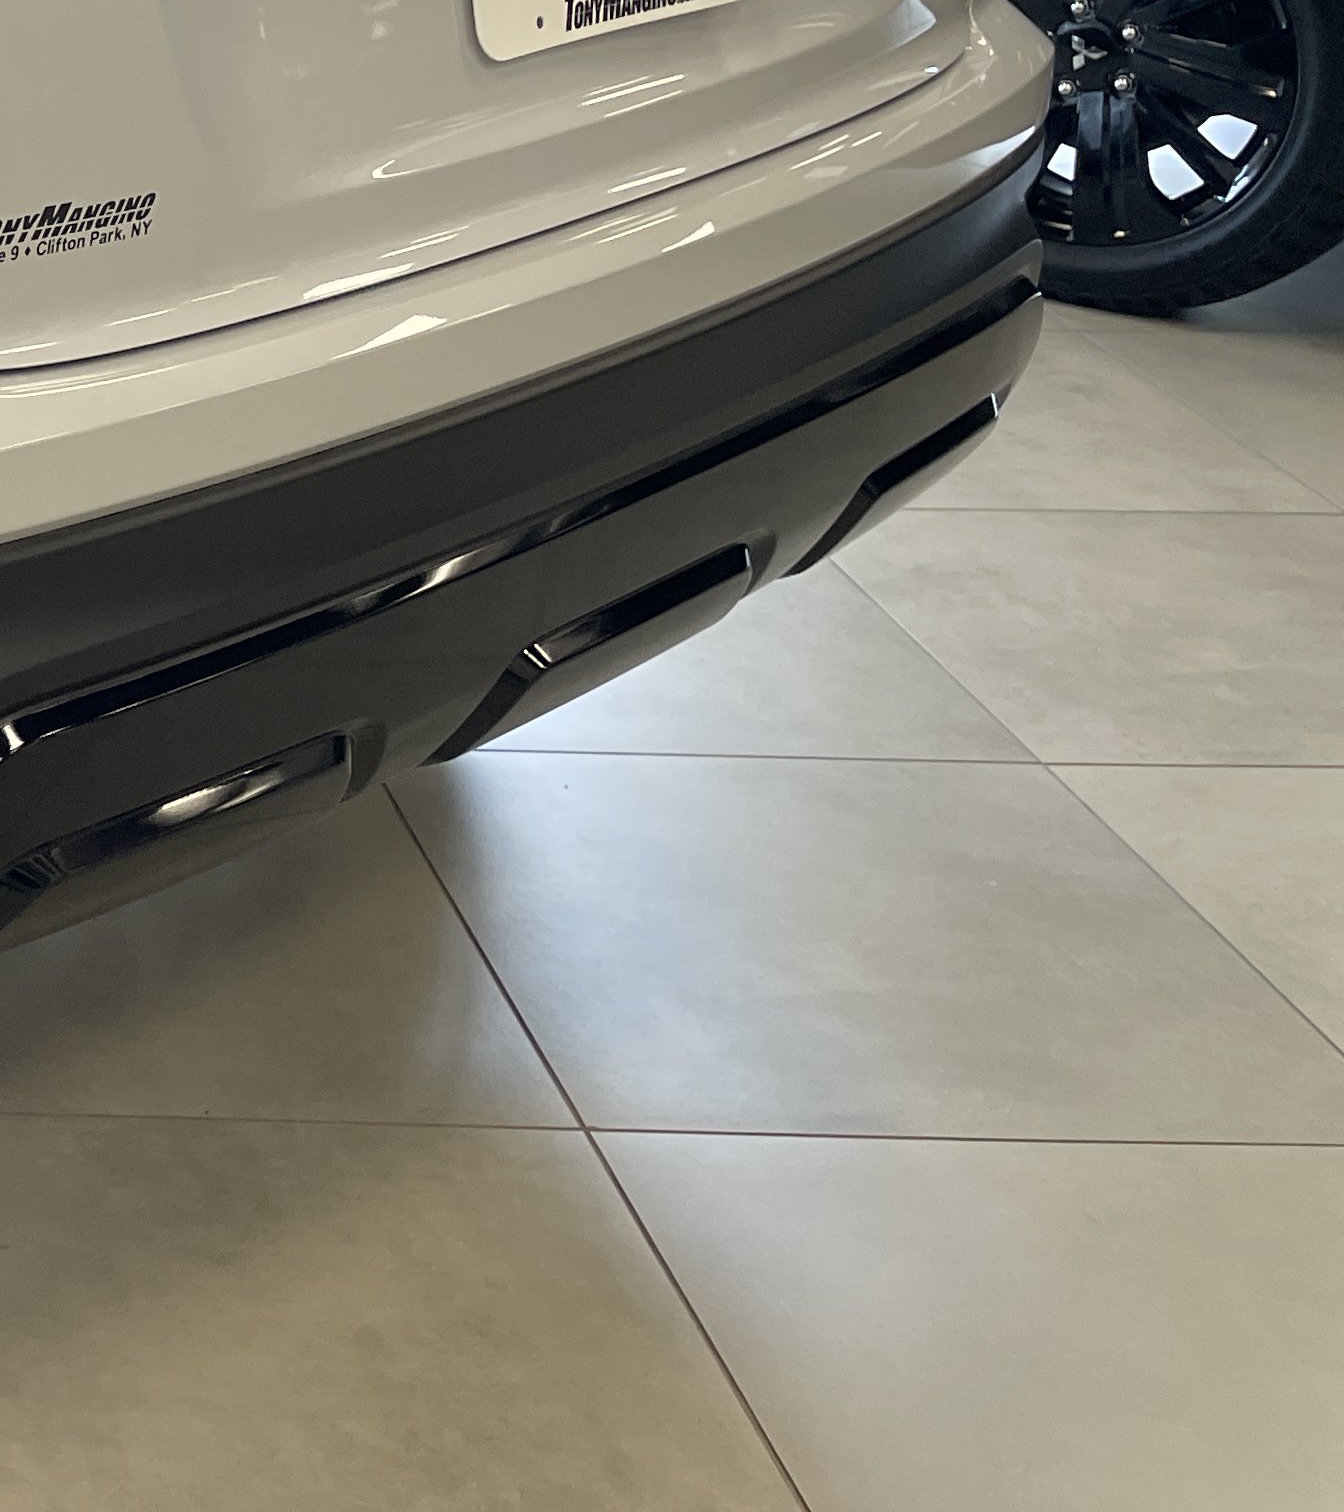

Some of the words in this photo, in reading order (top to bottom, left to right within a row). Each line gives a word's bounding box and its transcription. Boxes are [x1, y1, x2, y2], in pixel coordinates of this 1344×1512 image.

[10, 245, 20, 261] 9
[36, 238, 86, 257] Clifton
[89, 228, 127, 248] Park,
[130, 219, 154, 239] NY
